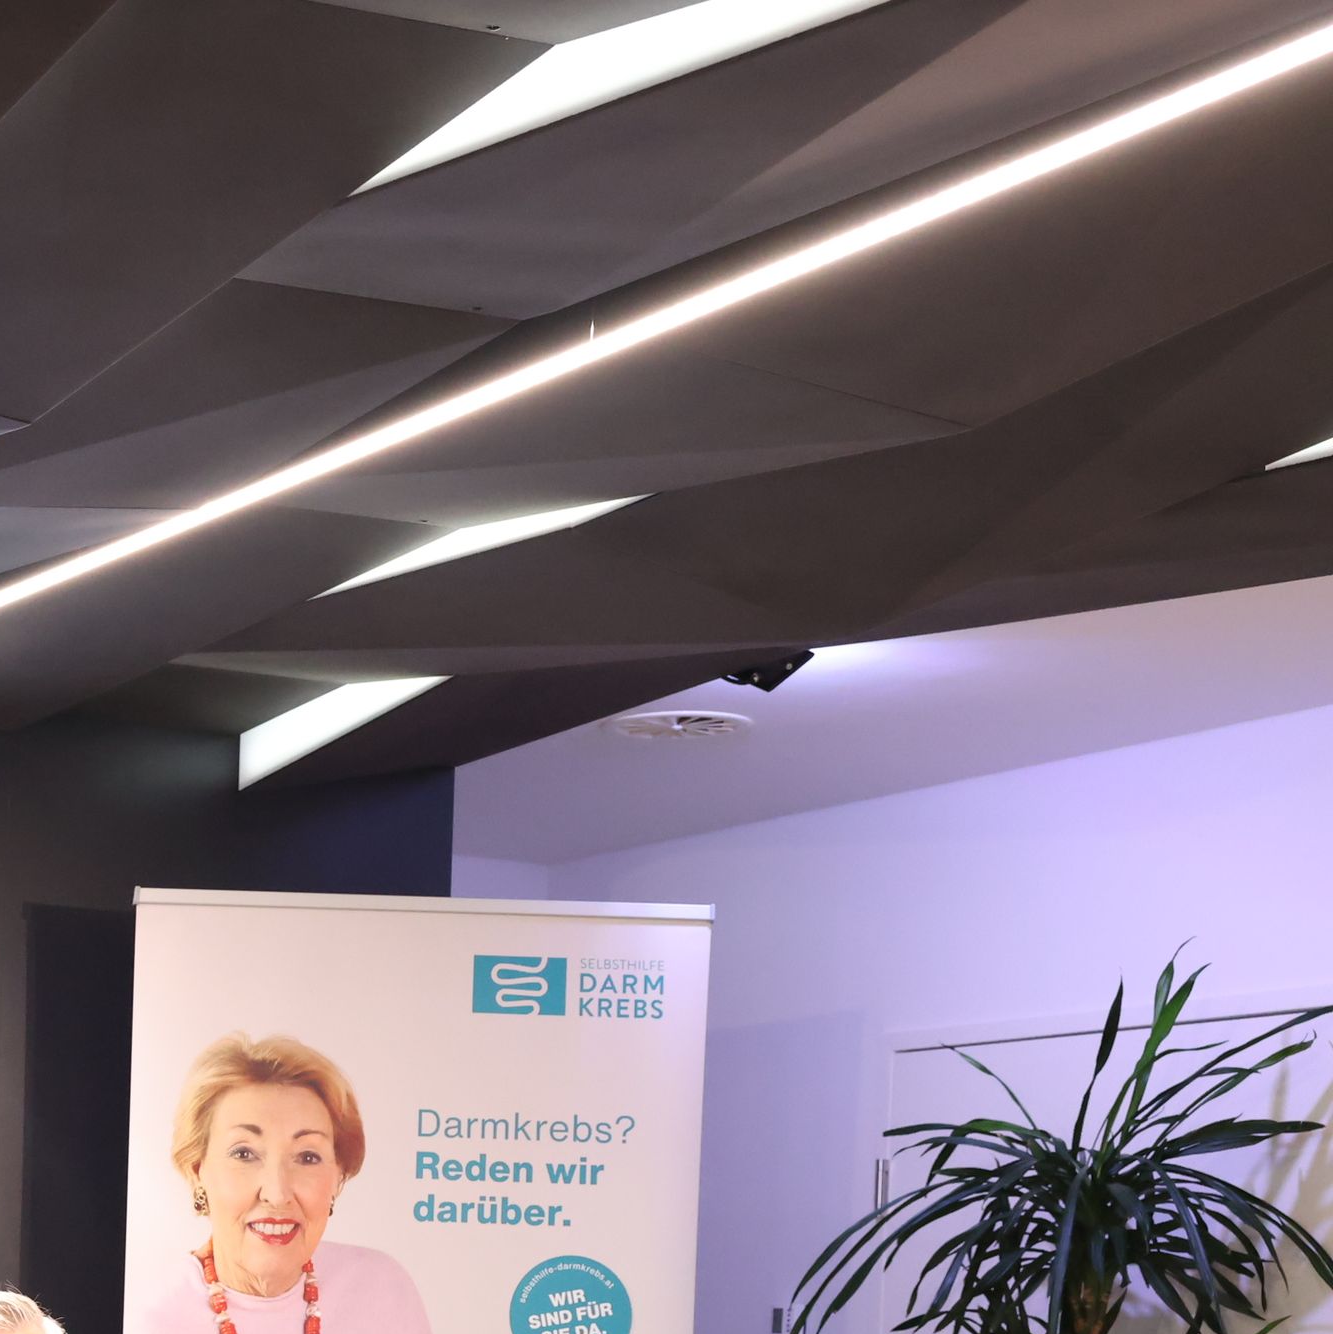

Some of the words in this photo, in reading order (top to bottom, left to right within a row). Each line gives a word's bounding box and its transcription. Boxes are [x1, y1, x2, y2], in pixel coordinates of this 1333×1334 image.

[580, 957, 665, 971] SELBSTHILFE
[579, 973, 664, 995] DARM
[578, 997, 663, 1019] KREBS
[416, 1109, 635, 1144] Darmkrebs?
[415, 1152, 533, 1183] Reden
[546, 1156, 604, 1185] wir
[413, 1194, 571, 1227] darüber.
[520, 1262, 615, 1304] selbsthilfe-darmkrebs.at
[549, 1289, 586, 1308] WIR
[528, 1310, 572, 1329] SIND
[576, 1302, 613, 1321] FÜR
